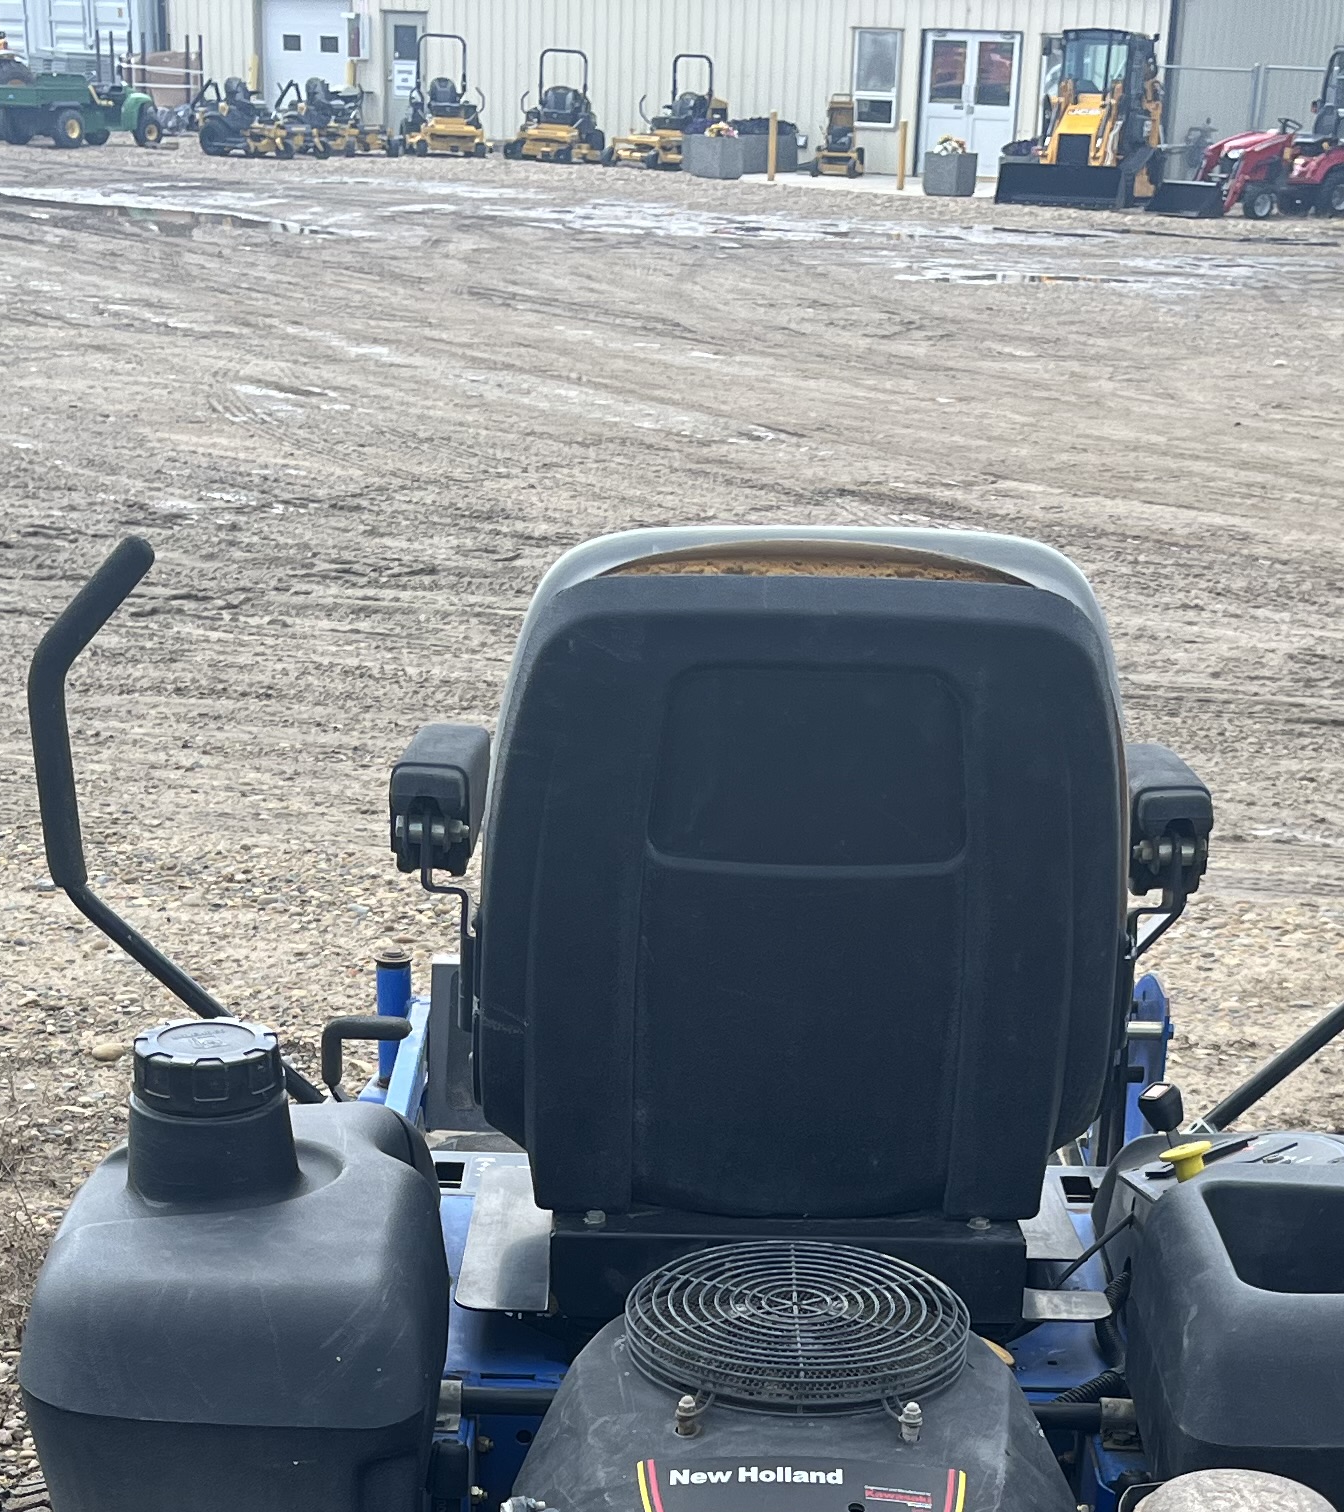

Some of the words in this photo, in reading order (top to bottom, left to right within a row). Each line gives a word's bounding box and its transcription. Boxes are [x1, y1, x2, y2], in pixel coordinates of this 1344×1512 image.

[669, 1468, 733, 1486] New
[738, 1466, 844, 1485] Holland
[864, 1489, 933, 1505] Kawasaki
